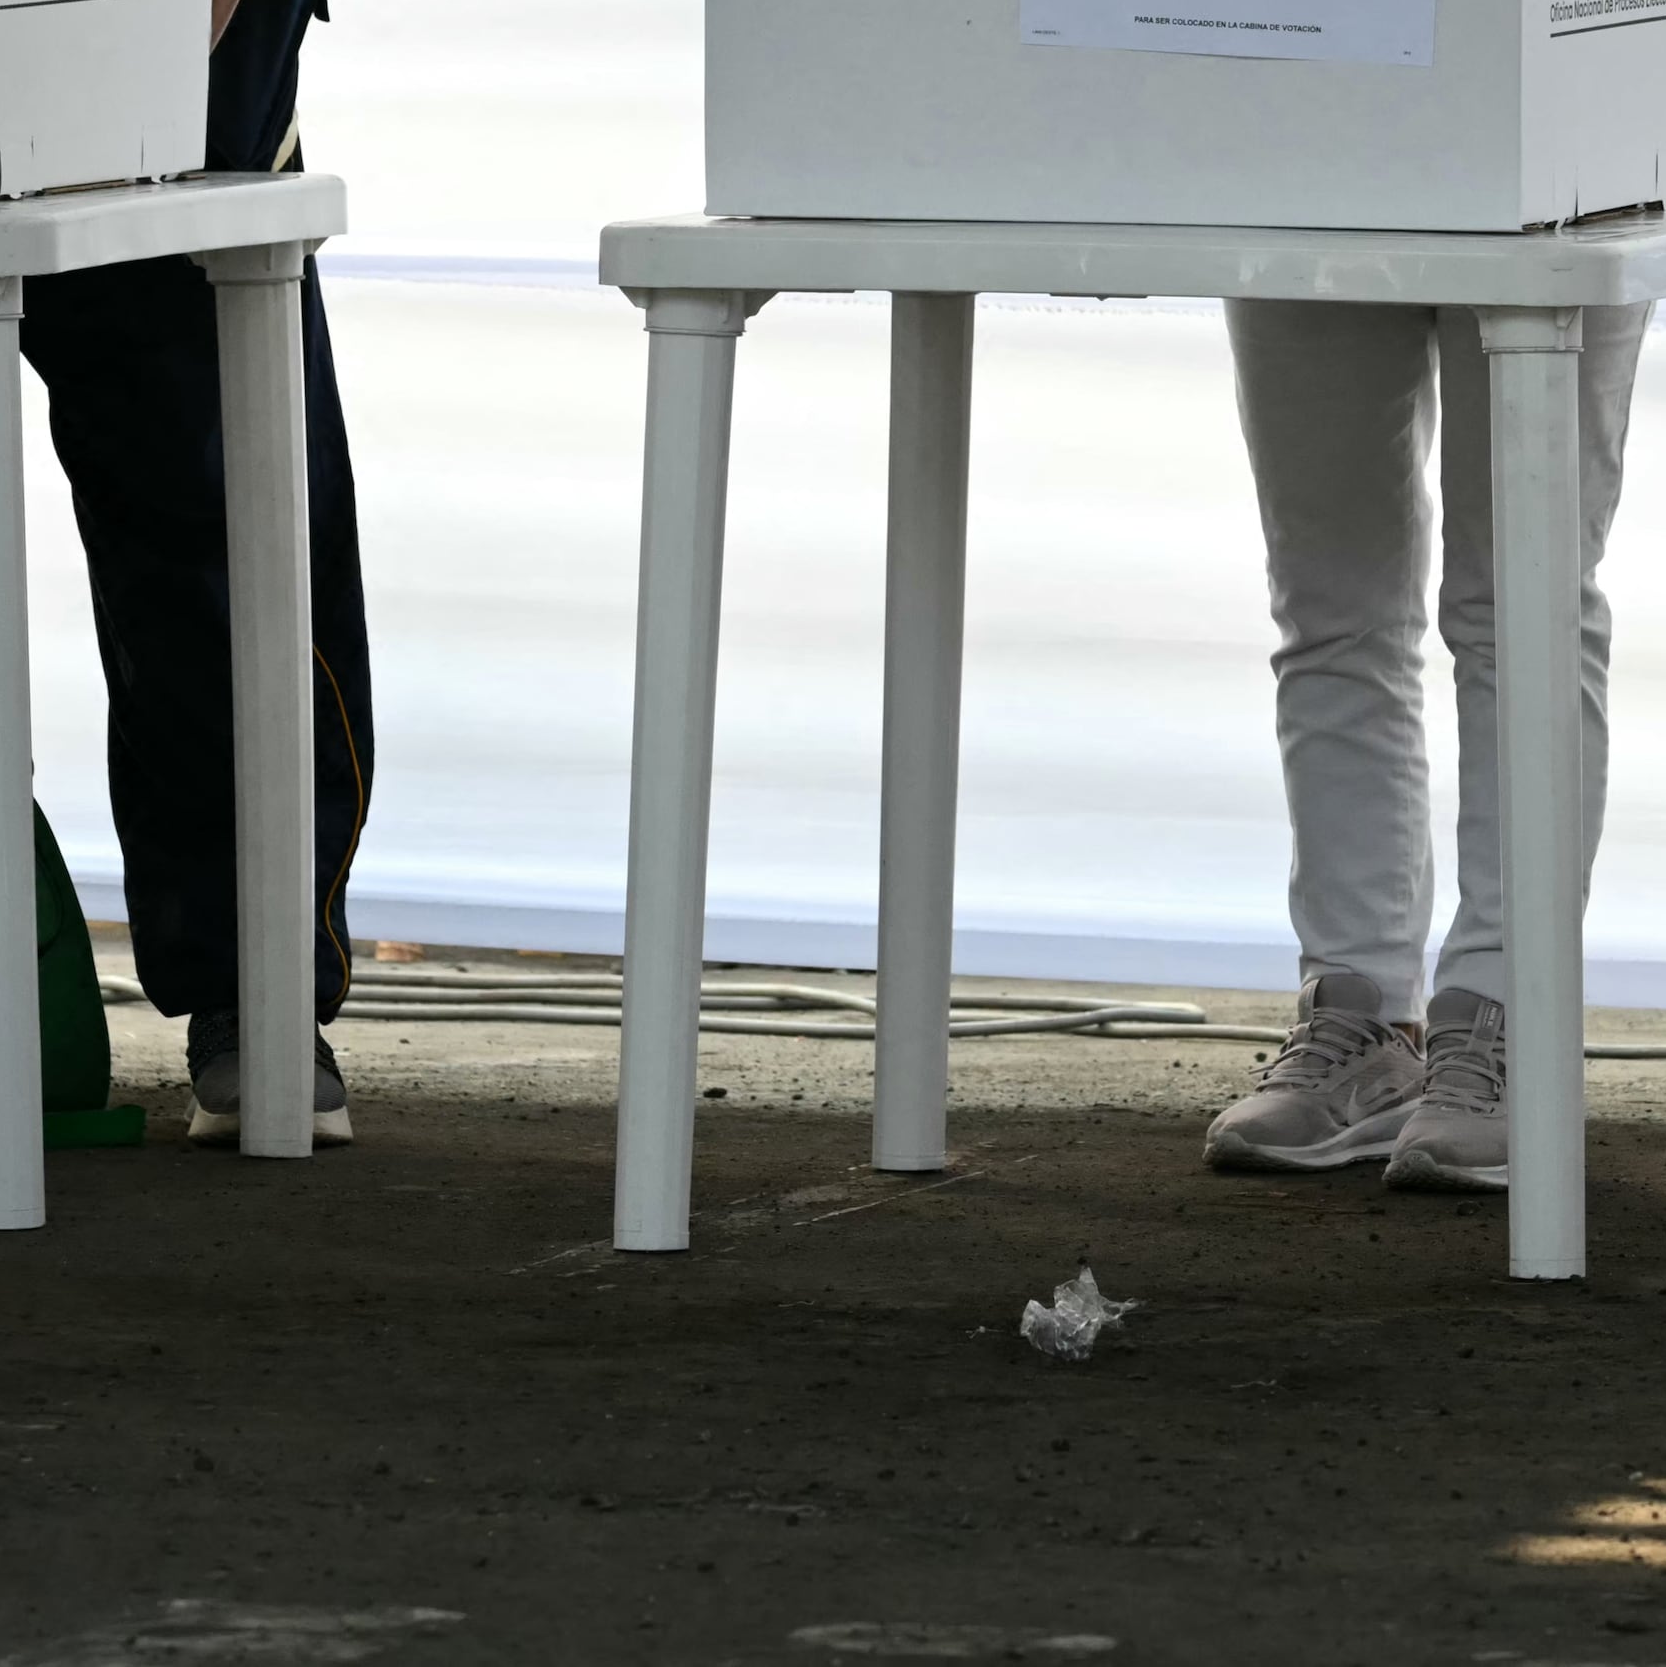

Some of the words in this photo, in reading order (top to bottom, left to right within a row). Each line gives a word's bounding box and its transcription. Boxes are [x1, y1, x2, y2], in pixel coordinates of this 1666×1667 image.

[1550, 2, 1573, 22] Oficina
[1135, 15, 1153, 24] PARA
[1156, 17, 1170, 25] SER
[1172, 18, 1214, 28] COLOCADO
[1216, 20, 1226, 28] EN
[1228, 21, 1237, 29] LA
[1239, 22, 1268, 30] CABINA
[1270, 23, 1279, 32] DE
[1282, 22, 1321, 33] VOTACIÓN
